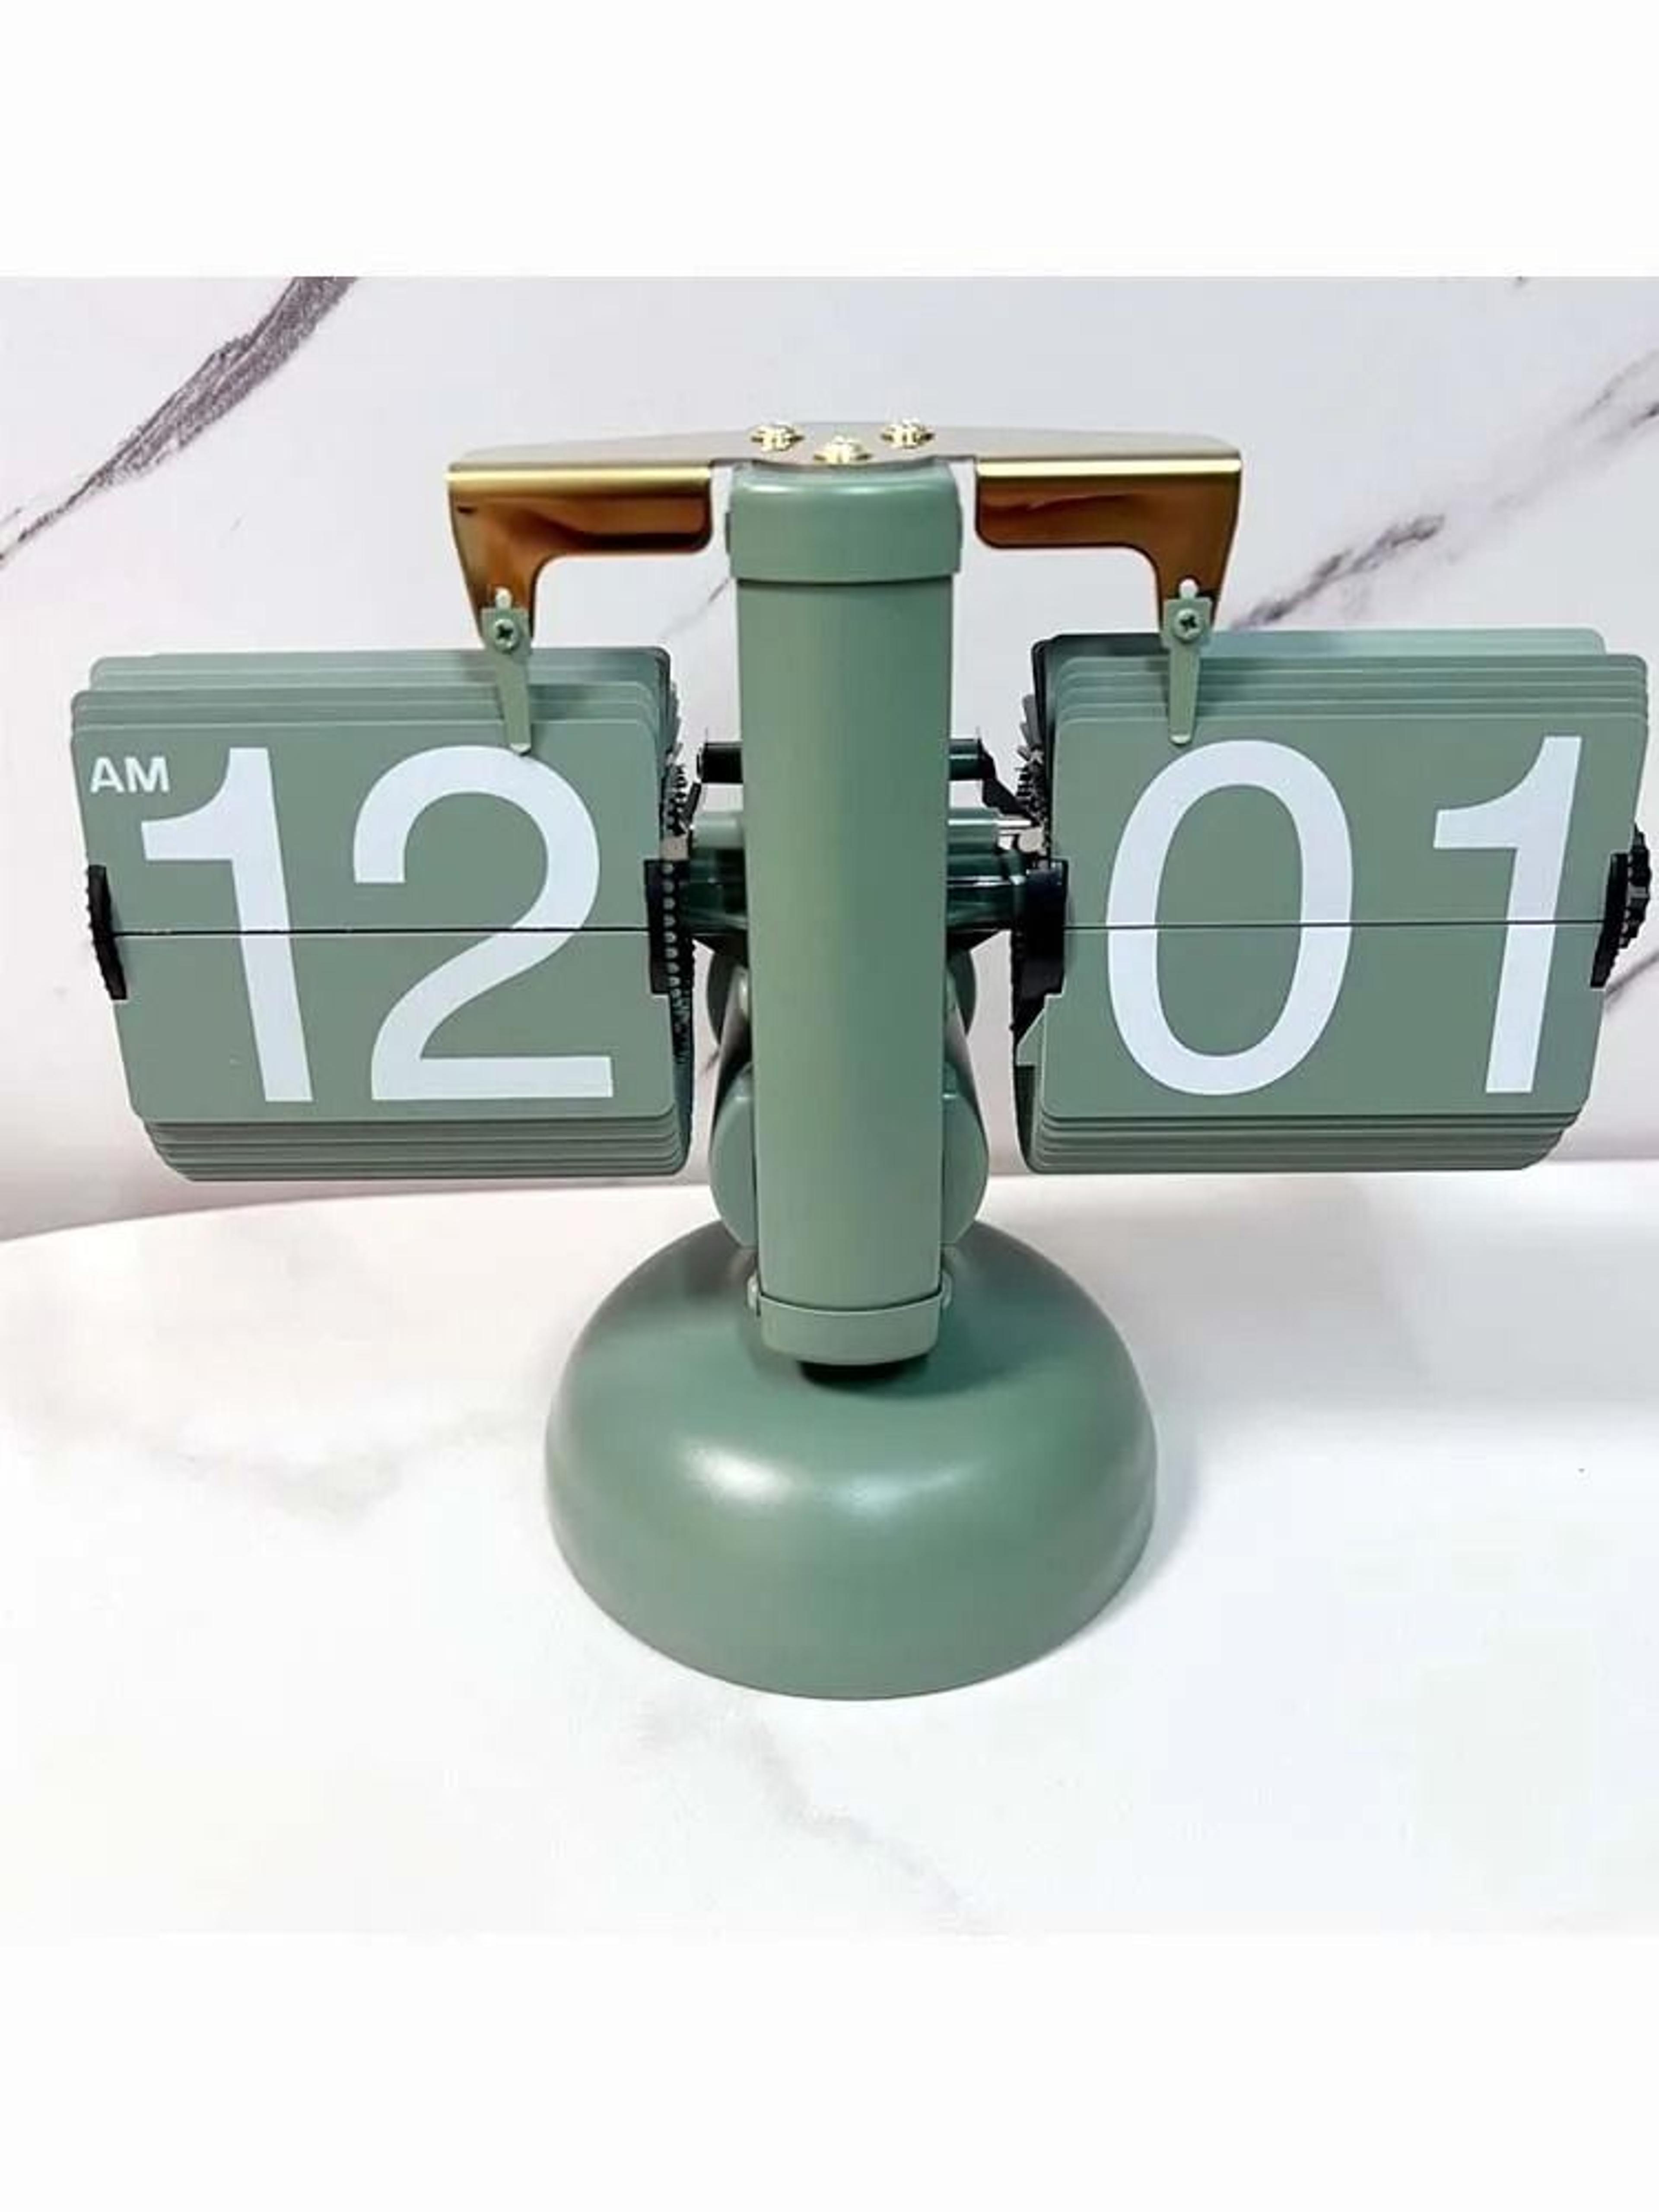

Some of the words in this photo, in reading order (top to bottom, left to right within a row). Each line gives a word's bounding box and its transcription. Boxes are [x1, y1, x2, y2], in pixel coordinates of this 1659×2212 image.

[89, 756, 170, 793] AM
[141, 745, 613, 1102] 12
[1105, 736, 1582, 1095] 01
